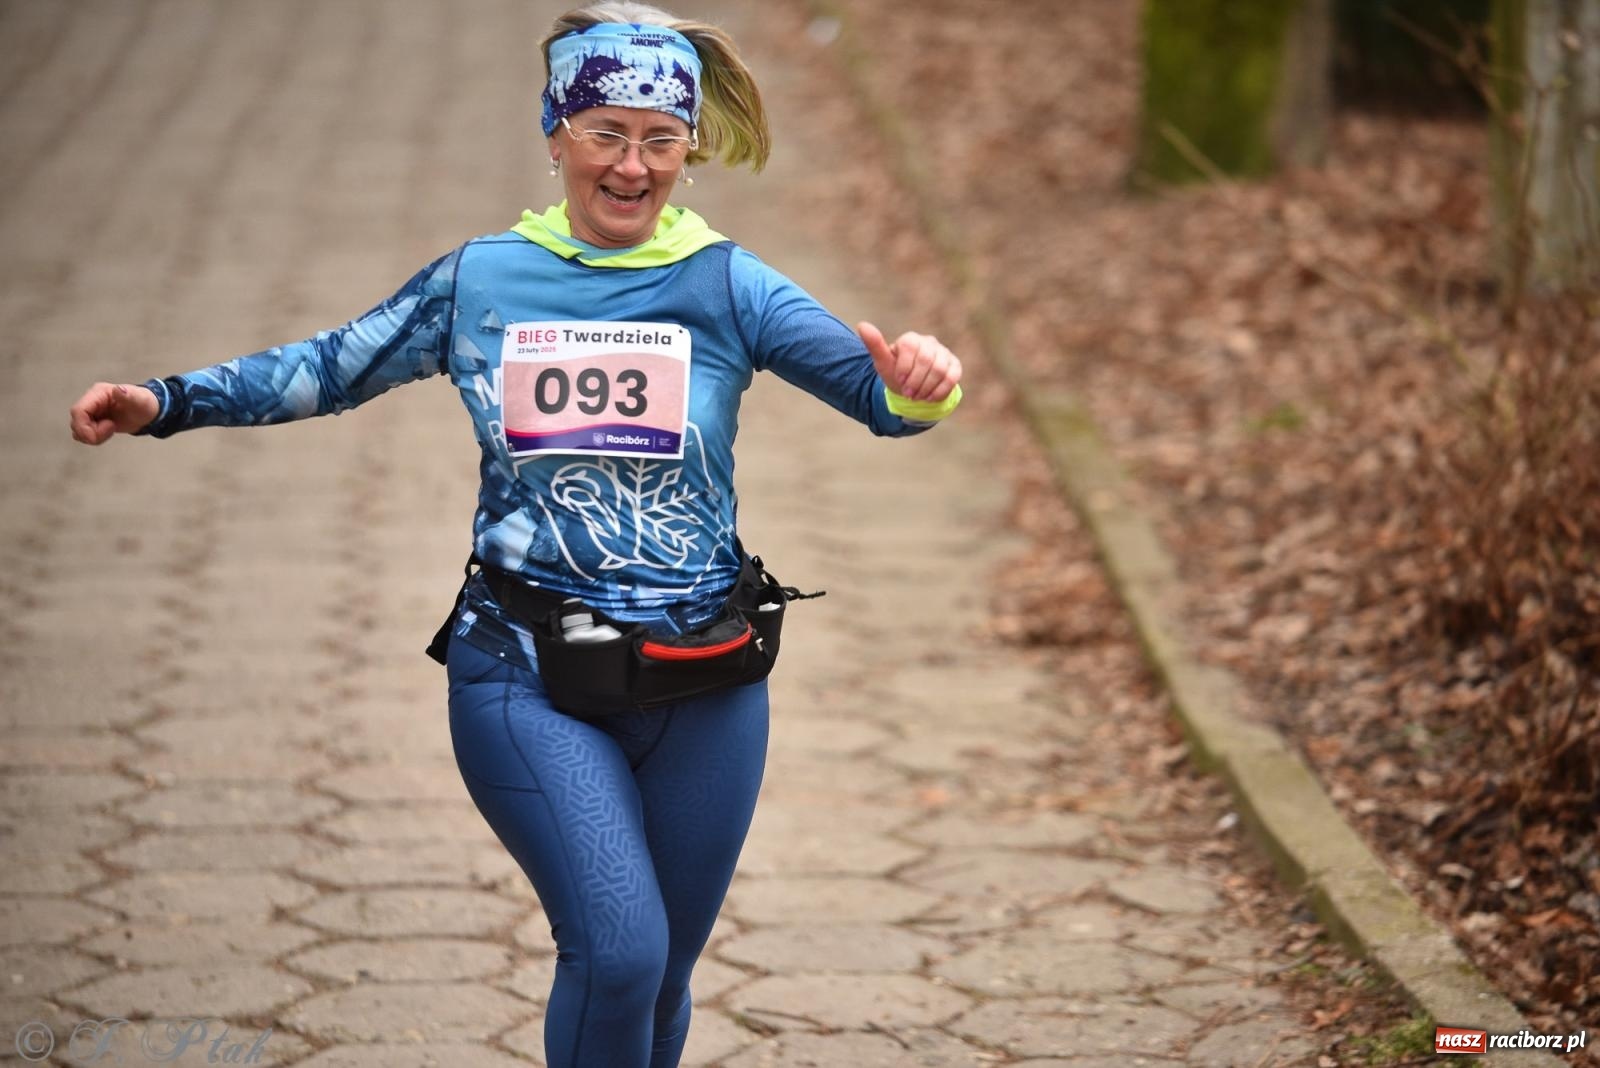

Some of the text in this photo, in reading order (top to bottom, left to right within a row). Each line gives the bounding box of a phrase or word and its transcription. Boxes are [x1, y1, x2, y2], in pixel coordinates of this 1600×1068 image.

[517, 329, 671, 345] BIEG Twardziela
[534, 367, 648, 418] 093
[606, 433, 650, 446] Racibórz
